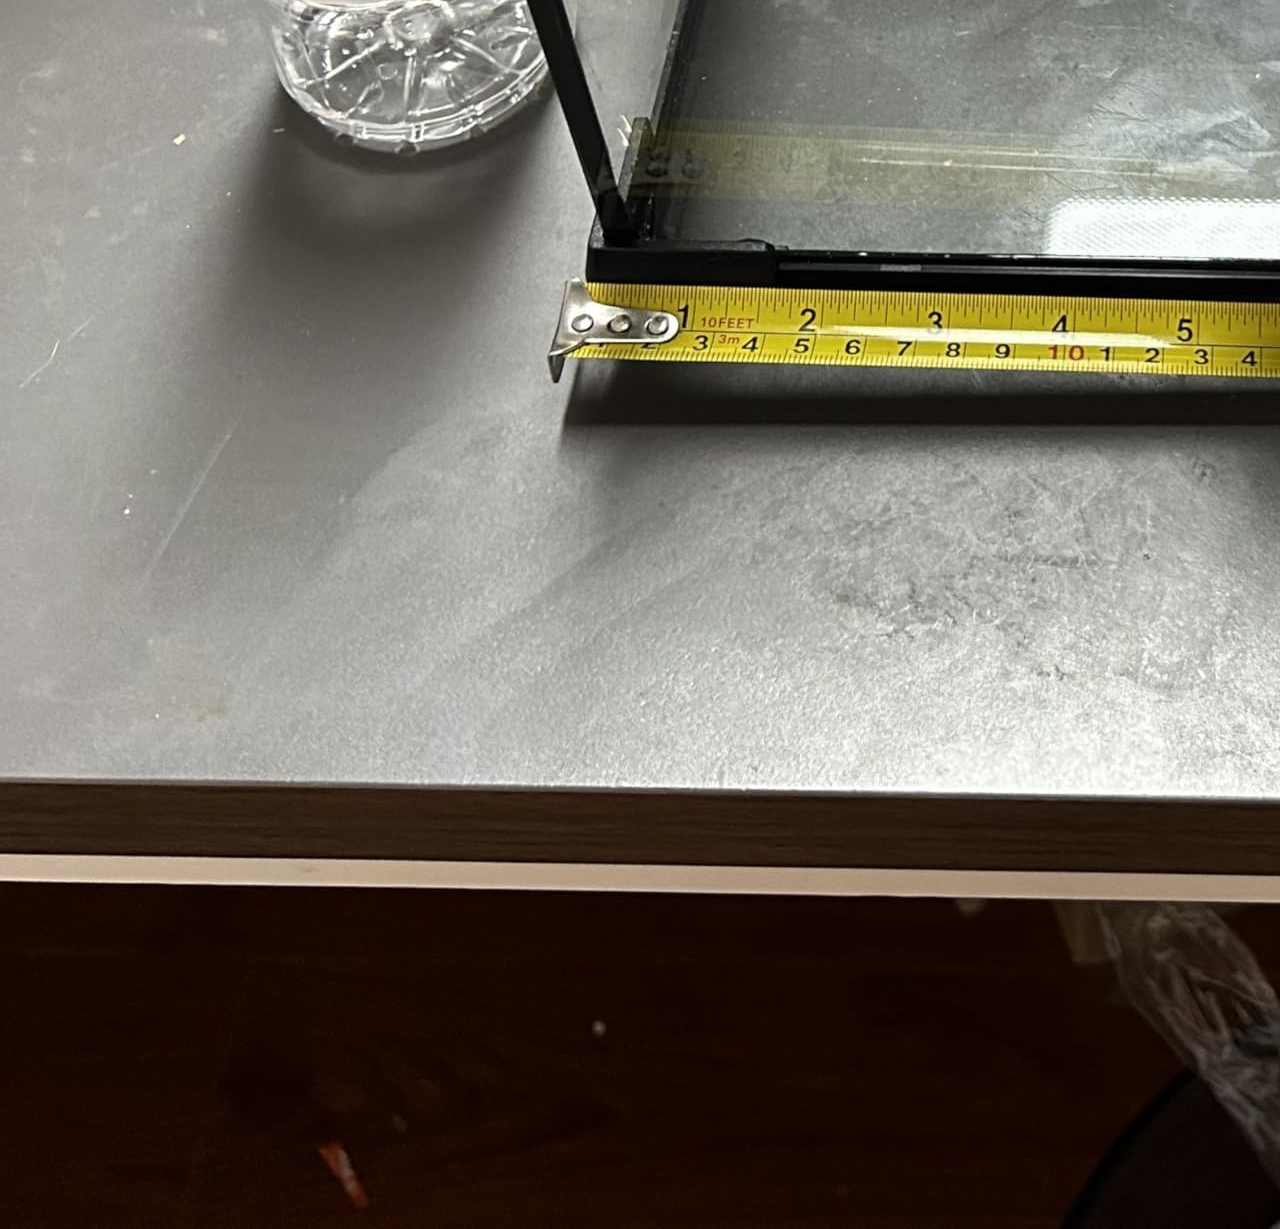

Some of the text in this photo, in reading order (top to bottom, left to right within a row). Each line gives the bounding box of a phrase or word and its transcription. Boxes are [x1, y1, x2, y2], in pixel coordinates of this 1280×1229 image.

[677, 304, 690, 329] 1
[701, 317, 755, 329] 10FEET
[798, 307, 817, 332] 2
[927, 311, 943, 335] 3
[1051, 314, 1068, 338] 4
[1177, 318, 1194, 342] 5
[692, 335, 709, 351] 3
[718, 334, 740, 344] 3m
[742, 336, 759, 353] 4
[794, 338, 810, 353] 5
[844, 339, 861, 355] 6
[896, 340, 913, 356] 7
[945, 342, 961, 358] 8
[995, 343, 1011, 359] 9
[1048, 344, 1085, 361] 10
[1099, 346, 1111, 361] 1
[1144, 347, 1160, 364] 2
[1194, 349, 1209, 365] 3
[1241, 351, 1258, 367] 4
